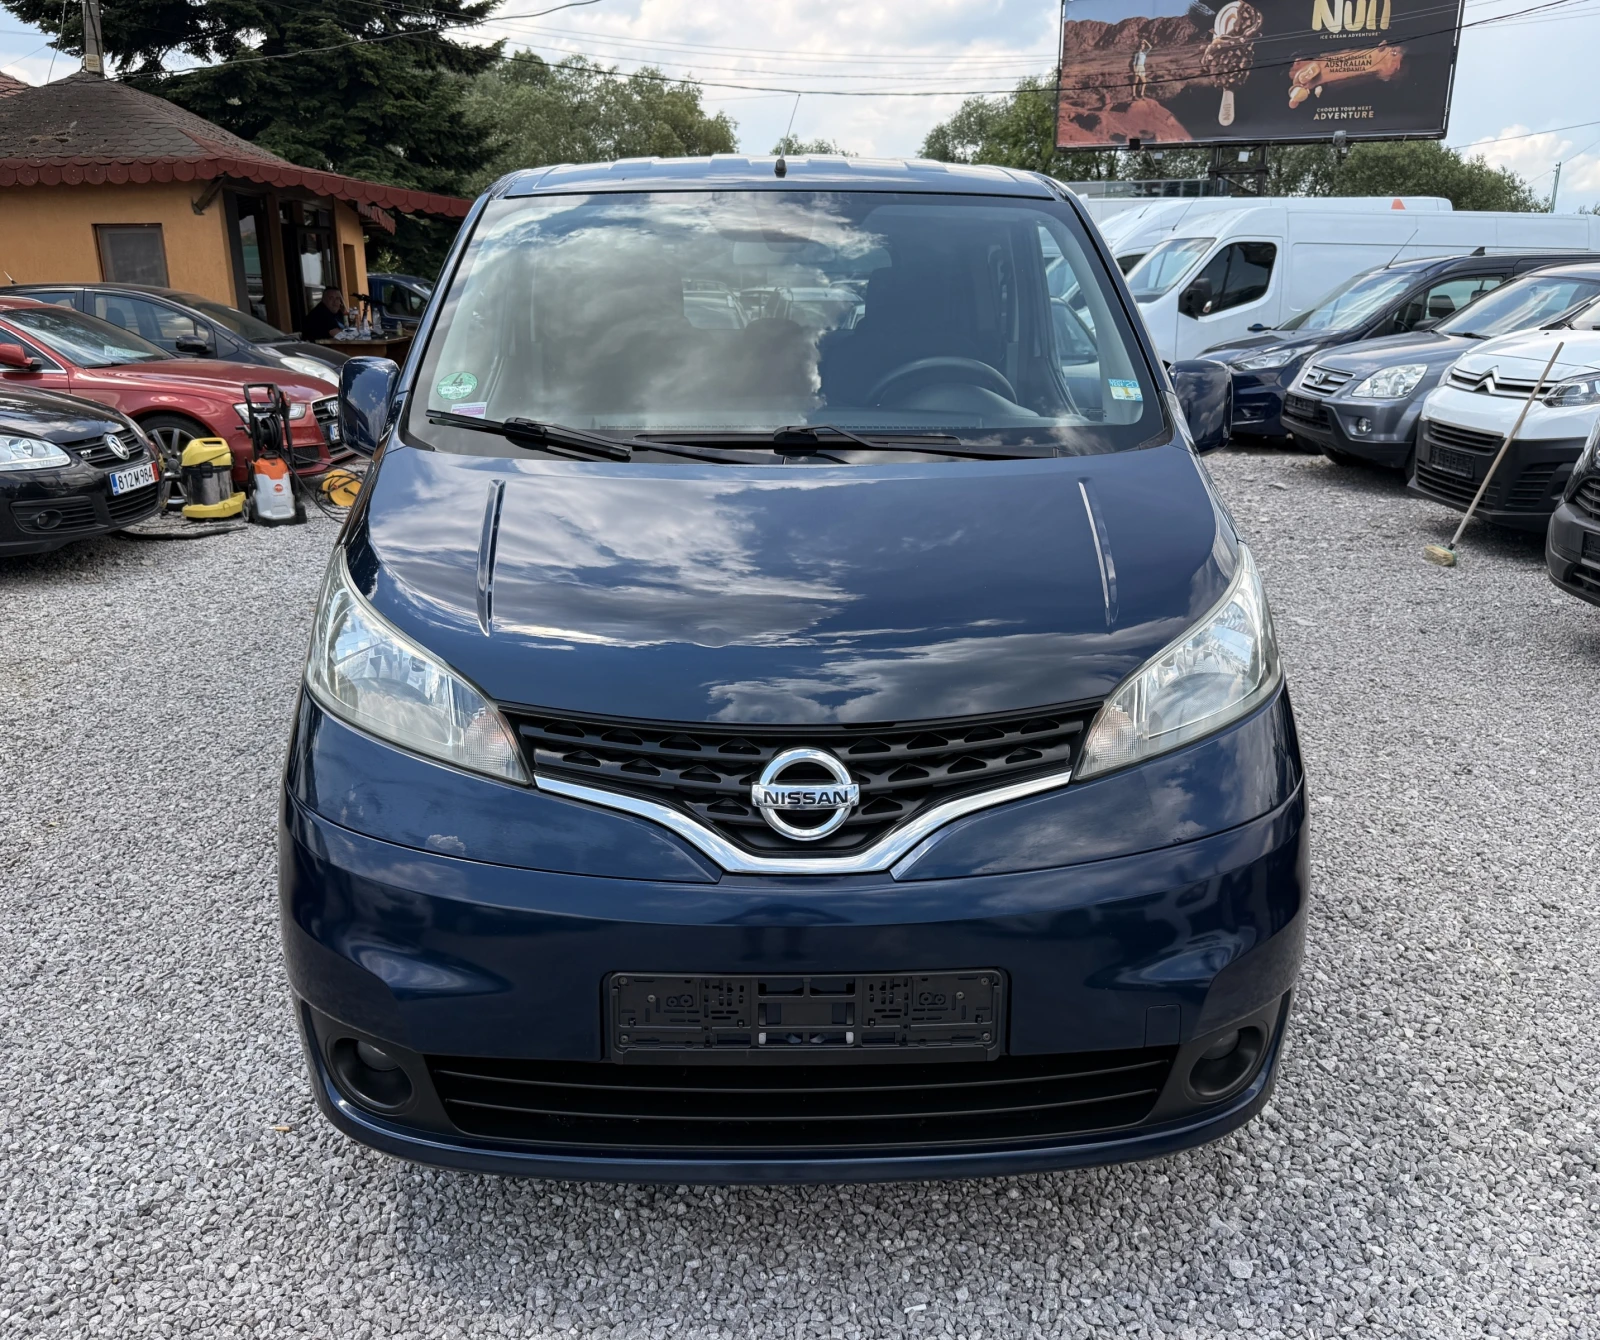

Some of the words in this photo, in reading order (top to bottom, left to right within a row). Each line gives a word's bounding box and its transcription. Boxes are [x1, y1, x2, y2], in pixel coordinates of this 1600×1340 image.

[1324, 60, 1372, 68] AUSTRALIAN
[1313, 111, 1374, 120] ADVENTURE
[117, 466, 154, 490] 812M984
[763, 790, 848, 805] NISSAN
